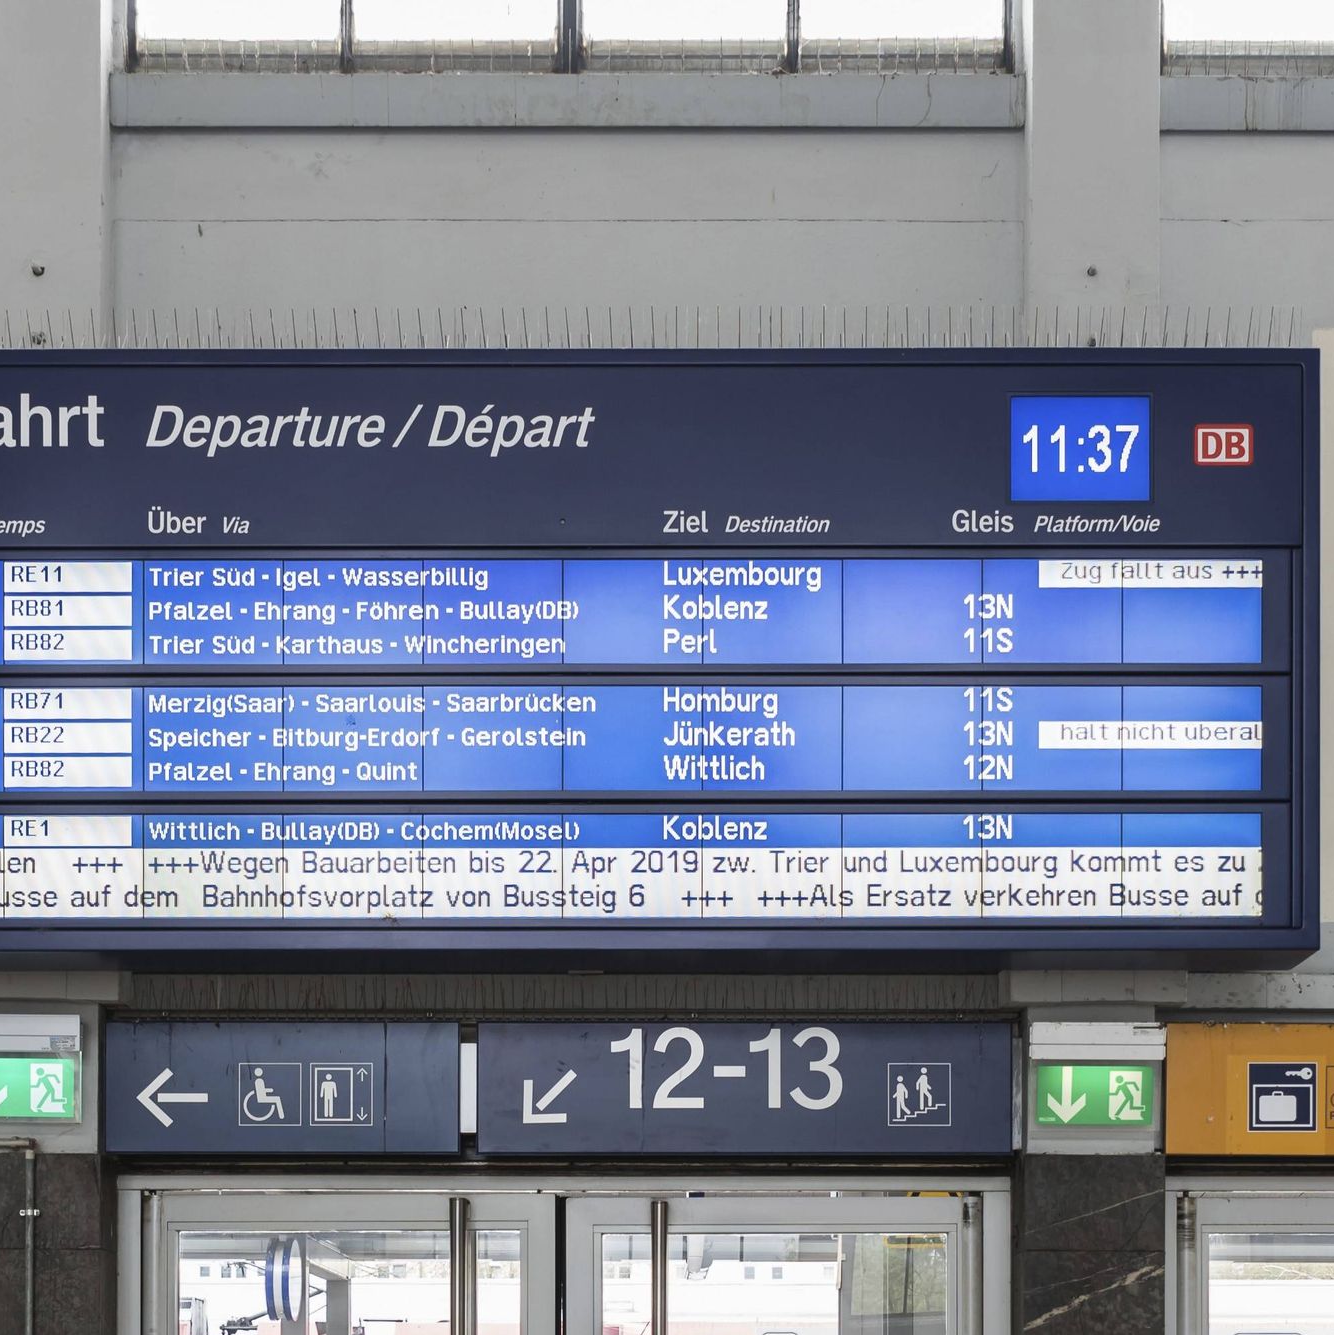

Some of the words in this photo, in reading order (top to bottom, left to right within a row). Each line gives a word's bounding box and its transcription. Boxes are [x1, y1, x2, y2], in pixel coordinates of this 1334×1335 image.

[146, 404, 384, 458] Departure
[429, 402, 595, 458] Départ
[1200, 430, 1247, 460] DB
[1022, 424, 1139, 474] 11:37
[148, 507, 206, 534] Über
[222, 516, 248, 534] Via
[663, 511, 708, 533] Ziel
[725, 515, 830, 534] Destination
[952, 511, 1014, 534] Gleis
[1033, 514, 1159, 534] Platform/Voie
[11, 566, 63, 582] RE11
[150, 568, 203, 587] Trier
[212, 567, 255, 587] Süd
[276, 568, 321, 591] Igel
[343, 568, 488, 591] Wasserbillig
[663, 561, 822, 591] Luxembourg
[1061, 562, 1102, 584] Zug
[1172, 565, 1212, 580] aus
[11, 600, 64, 616] RB81
[149, 602, 233, 621] Pfalzel
[255, 602, 336, 625] Ehrang
[356, 601, 439, 621] Föhren
[460, 602, 579, 624] Bullay(DB)
[663, 595, 768, 620] Koblenz
[963, 595, 1013, 620] 13N
[11, 634, 64, 650] RB82
[150, 636, 203, 654] Trier
[212, 635, 255, 654] Süd
[277, 636, 383, 654] Karthaus
[405, 635, 566, 658] Wincheringen
[663, 629, 717, 654] Perl
[963, 629, 1013, 654] 11S
[11, 693, 64, 709] RB71
[149, 694, 295, 717] Merzig(Saar)
[316, 694, 425, 713] Saarlouis
[447, 693, 596, 713] Saarbrücken
[663, 688, 778, 718] Homburg
[963, 688, 1013, 712] 11S
[11, 726, 64, 742] RB22
[149, 728, 251, 751] Speicher
[273, 728, 441, 751] Bitburg-Erdorf
[461, 728, 586, 747] Gerolstein
[663, 721, 796, 747] Jünkerath
[963, 722, 1013, 747] 13N
[1118, 724, 1175, 740] nicht
[11, 760, 64, 776] RB82
[149, 762, 233, 781] Pfalzel
[255, 762, 336, 785] Ehrang
[356, 762, 417, 781] Quint
[663, 755, 765, 781] Wittlich
[963, 756, 1013, 781] 12N
[11, 820, 50, 837] RE1
[149, 822, 240, 841] Wittlich
[261, 822, 380, 844] Bullay(DB)
[401, 822, 579, 842] Cochem(Mosel)
[663, 815, 768, 841] Koblenz
[963, 815, 1013, 841] 13N
[302, 851, 456, 874] Bauarbeiten
[469, 850, 505, 874] bis
[518, 850, 557, 874] 22.
[572, 851, 617, 879] Apr
[630, 850, 699, 874] 2019
[714, 857, 756, 874] zw.
[769, 850, 829, 873] Trier
[844, 851, 887, 873] und
[901, 850, 1058, 879] Luxembourg
[1174, 856, 1204, 873] es
[1218, 856, 1245, 872] zu
[71, 885, 111, 908] auf
[124, 885, 178, 908] dem
[202, 885, 433, 913] Bahnhofsvorplatz
[447, 890, 491, 908] von
[504, 885, 616, 913] Bussteig
[629, 884, 646, 908] 6
[867, 884, 952, 907] Ersatz
[965, 884, 1097, 907] verkehren
[1109, 884, 1188, 907] Busse
[1202, 883, 1243, 906] auf
[611, 1027, 843, 1110] 12-13
